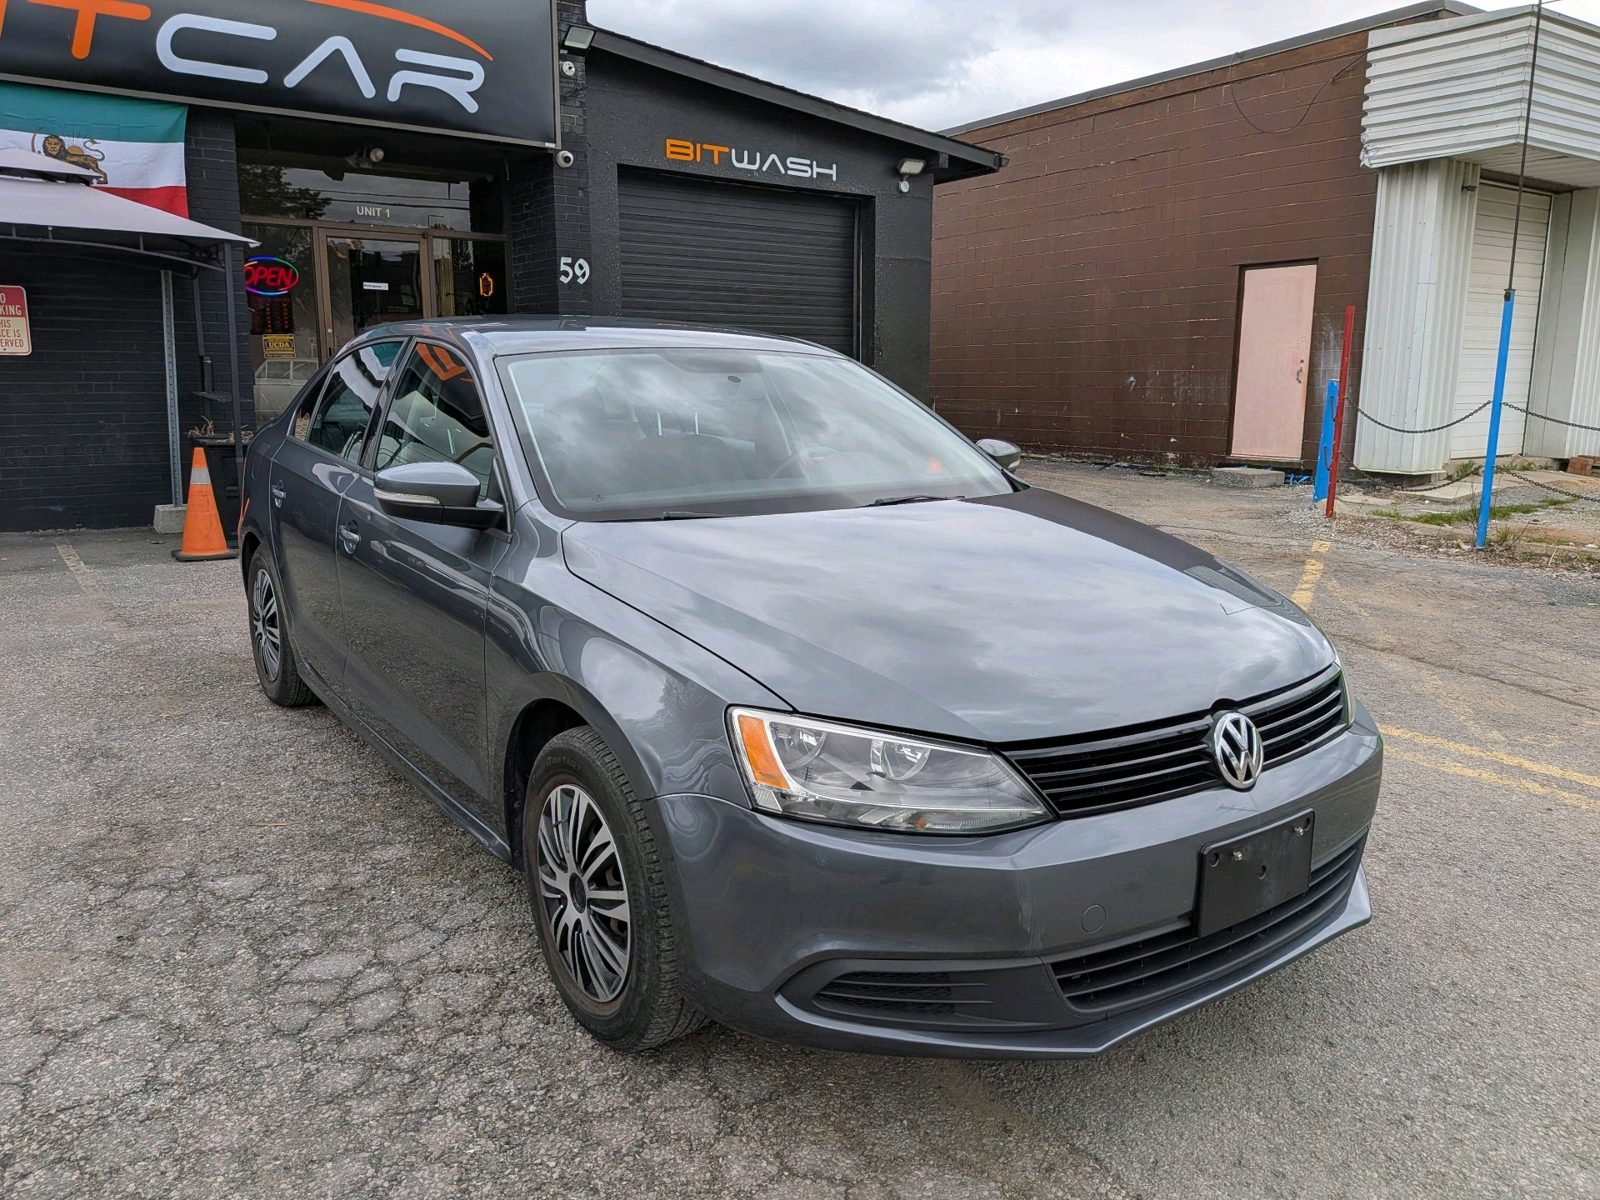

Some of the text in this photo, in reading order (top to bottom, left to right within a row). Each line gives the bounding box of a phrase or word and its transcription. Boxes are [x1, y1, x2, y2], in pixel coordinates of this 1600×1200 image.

[666, 138, 837, 182] BITWASH
[356, 205, 391, 218] UNIT 1
[244, 266, 294, 288] OPEN
[560, 256, 590, 285] 59
[0, 304, 22, 316] KING
[13, 329, 21, 338] IS
[0, 338, 24, 348] ERVED
